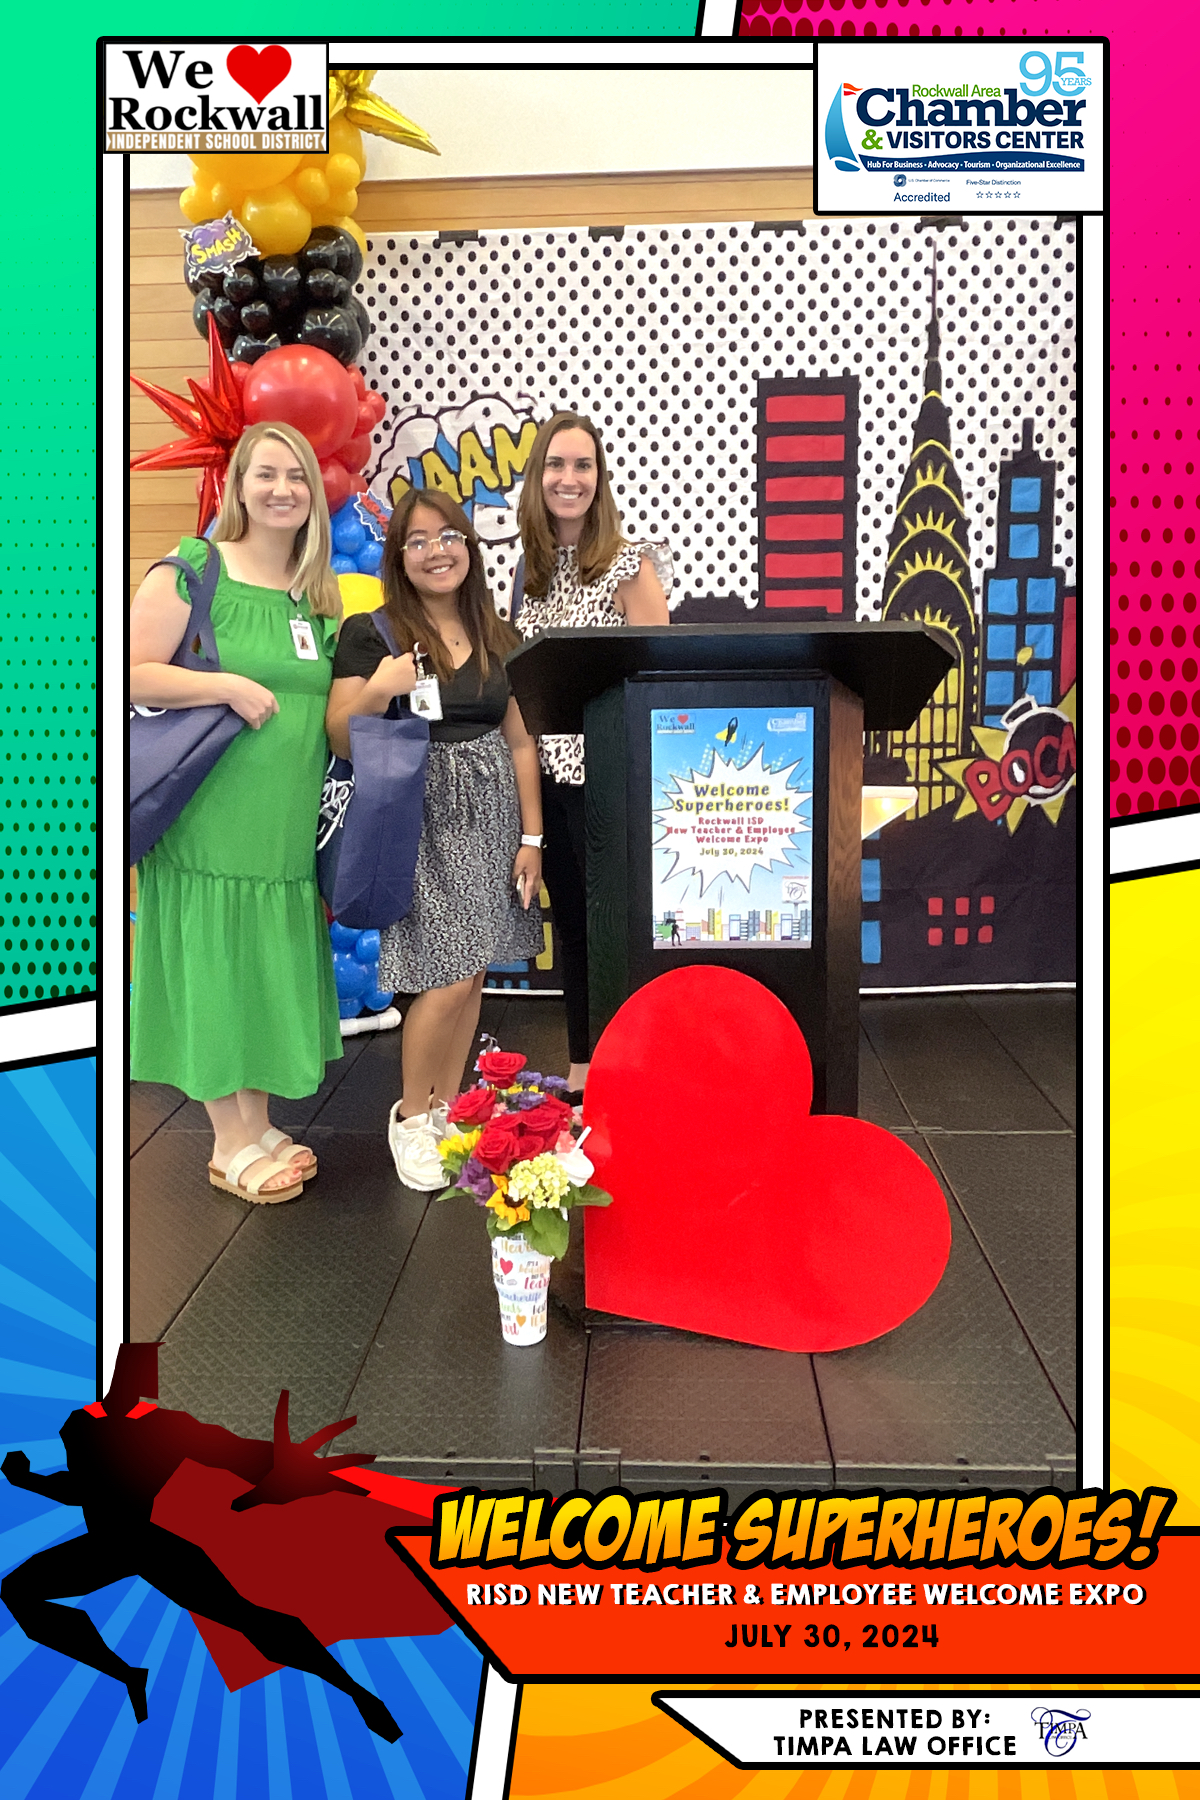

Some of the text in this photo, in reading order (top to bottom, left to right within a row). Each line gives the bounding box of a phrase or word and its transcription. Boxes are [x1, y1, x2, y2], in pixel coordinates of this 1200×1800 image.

[191, 227, 242, 264] SMASH
[390, 422, 538, 505] AAM
[693, 783, 770, 798] Welcome
[675, 798, 789, 815] Superheroes!
[698, 817, 764, 825] Rockwall ISD
[666, 826, 796, 836] New Teacher & Employee
[696, 835, 769, 844] Welcome Expo
[699, 847, 720, 857] July
[740, 847, 764, 855] 2024
